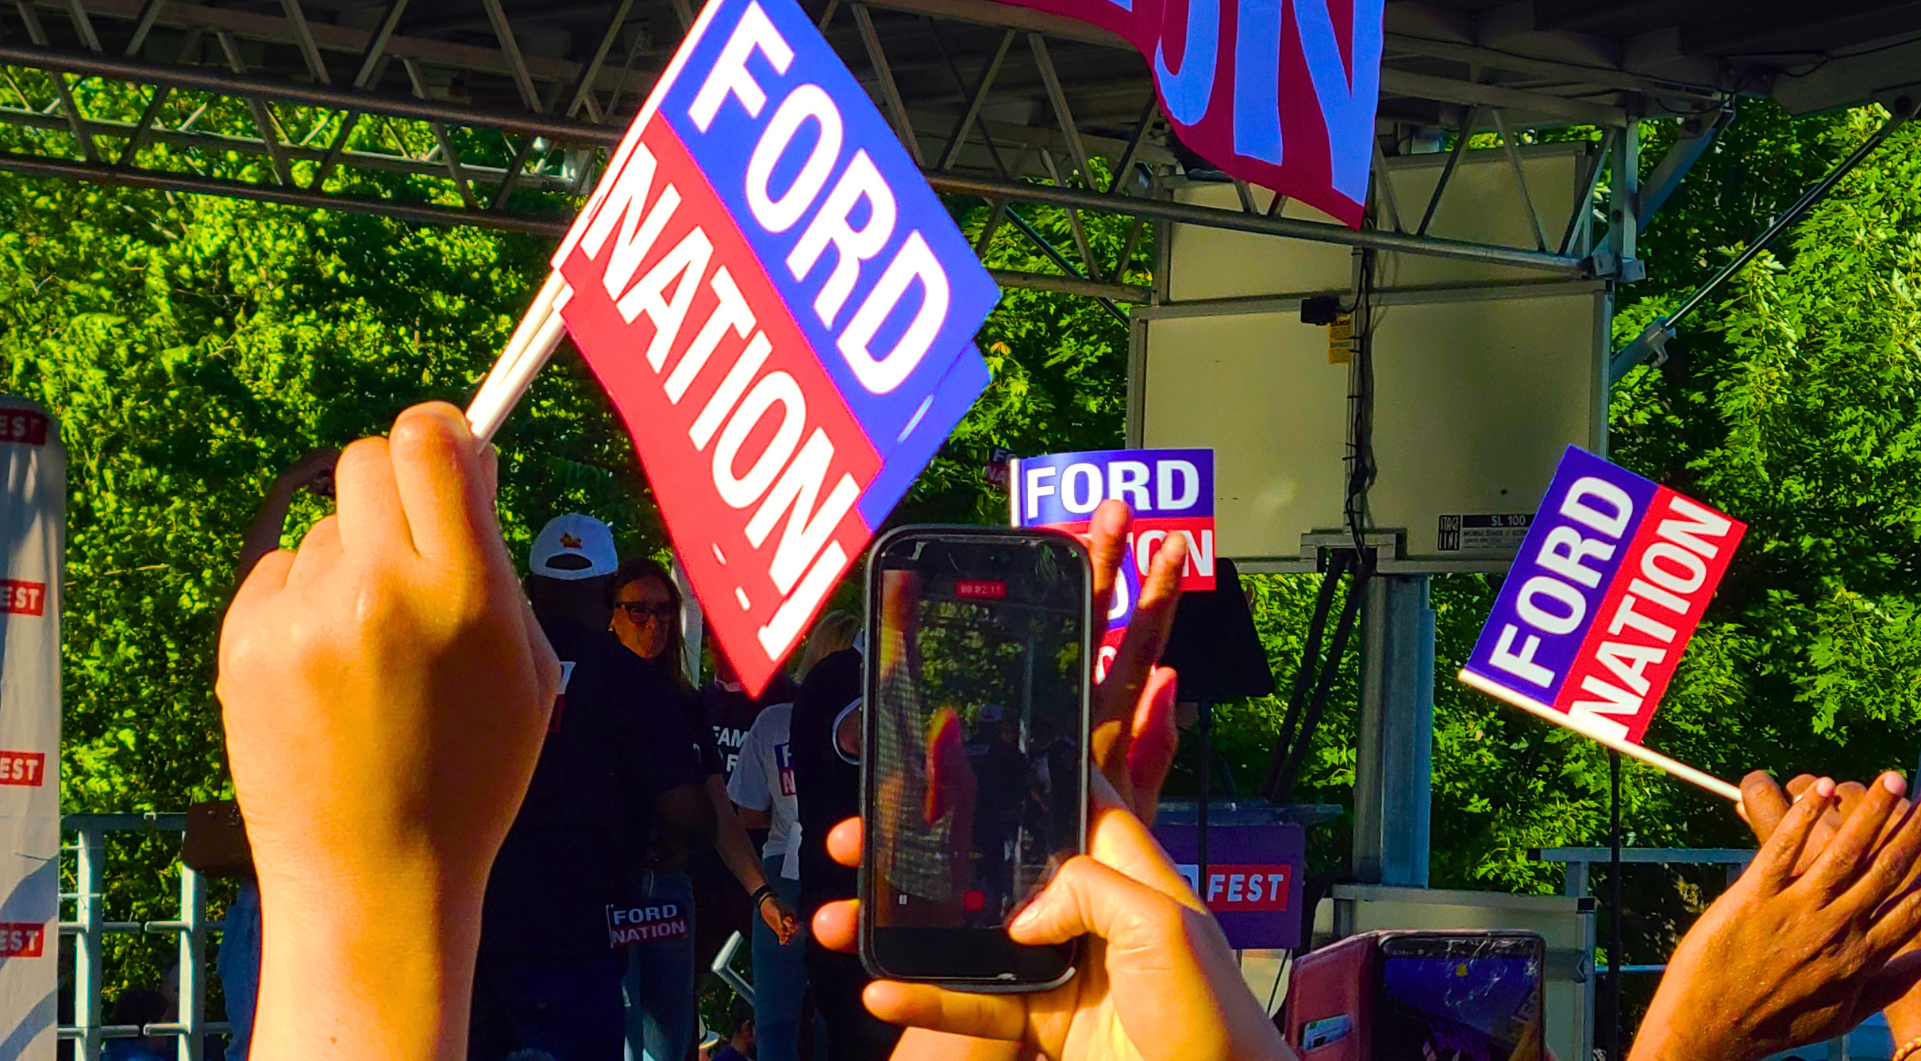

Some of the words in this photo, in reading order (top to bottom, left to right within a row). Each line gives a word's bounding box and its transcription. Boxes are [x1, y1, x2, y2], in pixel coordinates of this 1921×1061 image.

[687, 0, 950, 394] FORD
[579, 141, 862, 597] NATION
[1026, 460, 1200, 519] FORD
[1491, 515, 1503, 526] SL
[1508, 515, 1526, 526] 100
[1488, 476, 1634, 688] FORD
[1567, 495, 1732, 741] NATION
[613, 904, 677, 925] FORD
[1207, 873, 1284, 902] FEST
[611, 920, 685, 943] NATION
